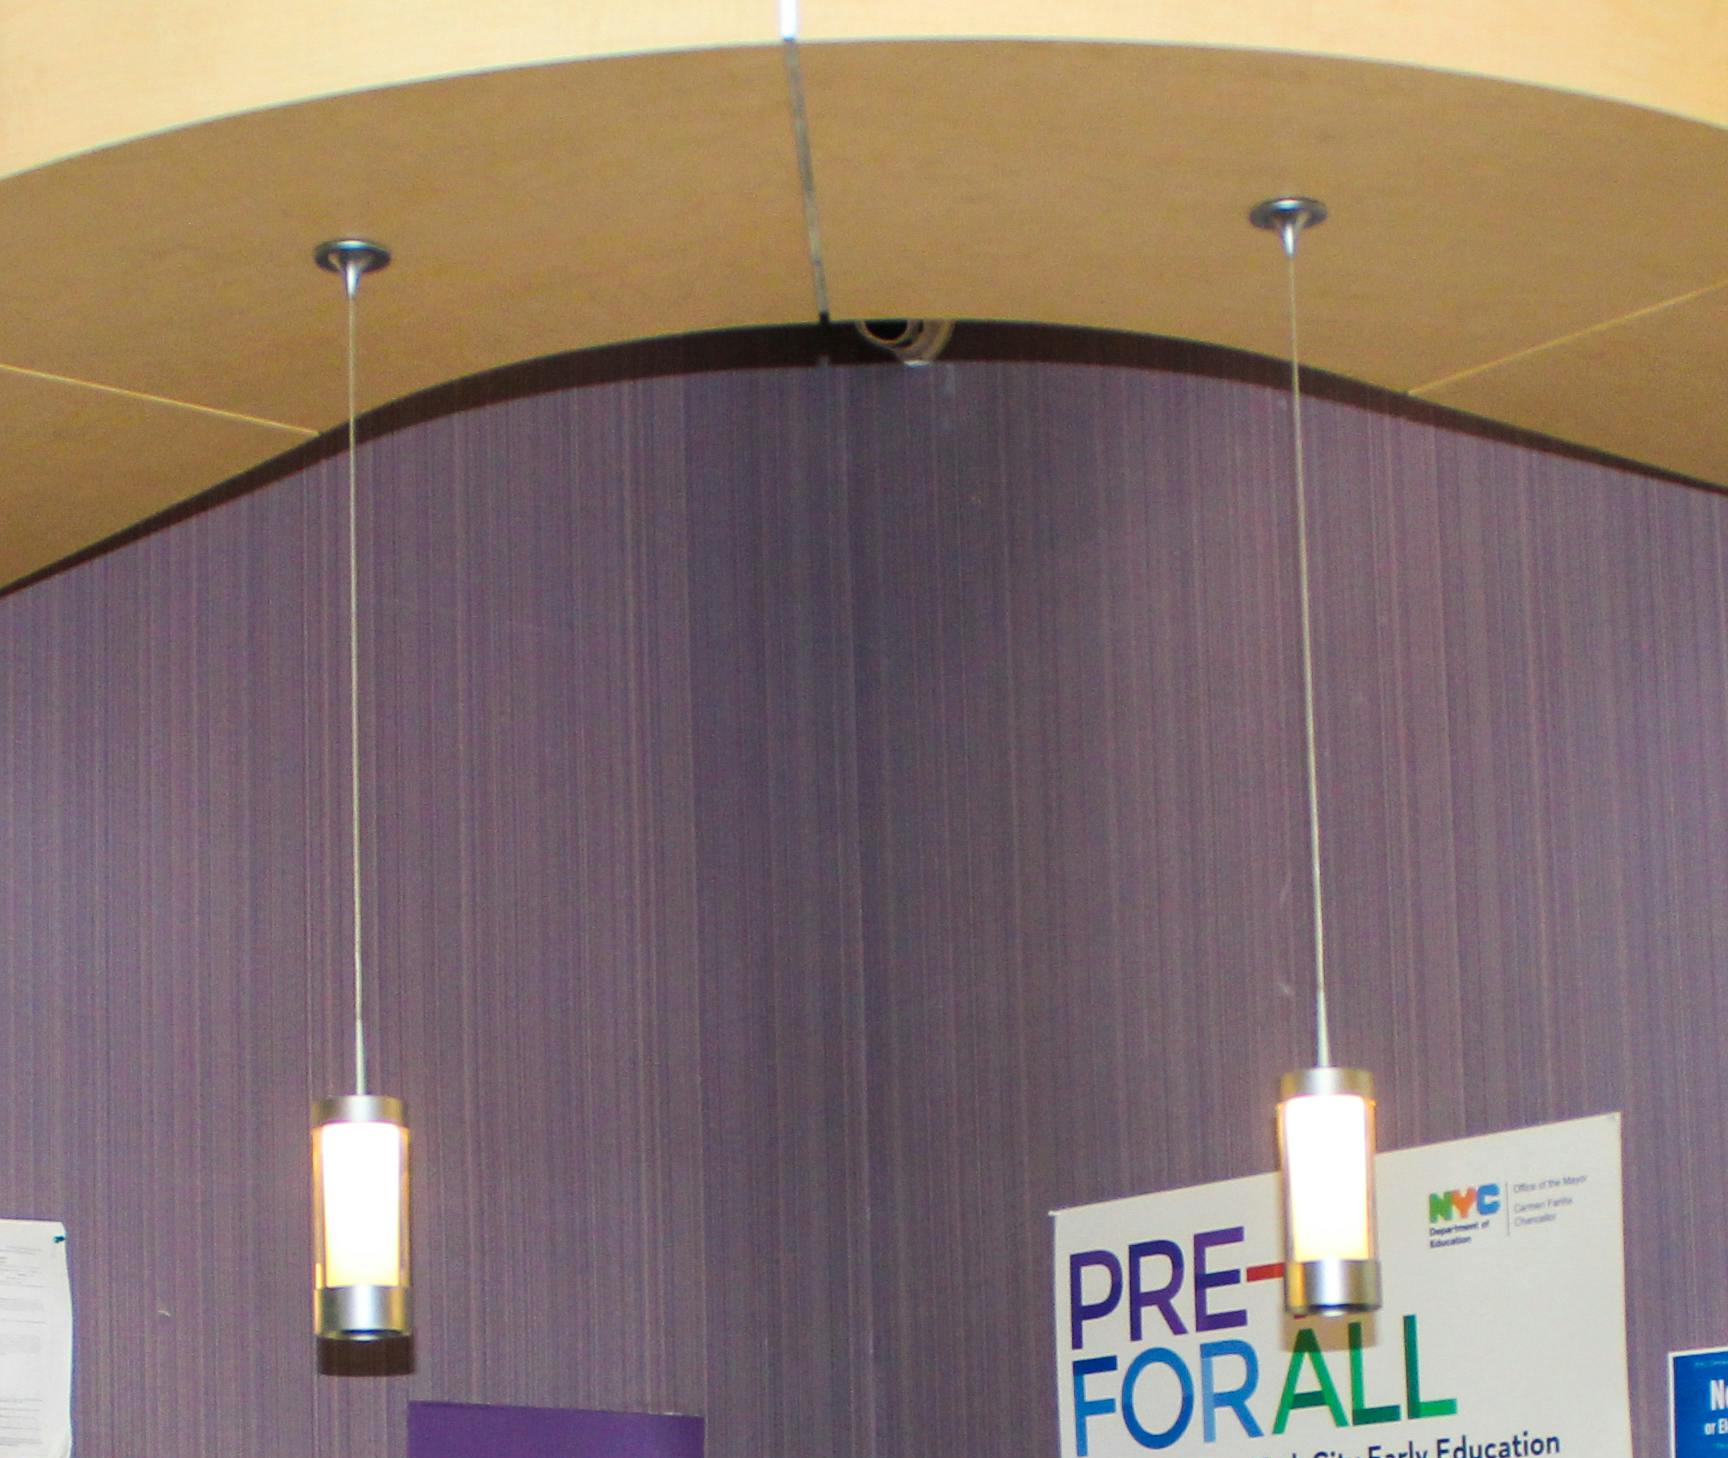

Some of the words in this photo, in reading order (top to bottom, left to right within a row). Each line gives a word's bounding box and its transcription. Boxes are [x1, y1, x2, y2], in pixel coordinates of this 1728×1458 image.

[1428, 1183, 1501, 1223] NYC
[1430, 1222, 1478, 1237] Department
[1481, 1220, 1490, 1229] of
[1430, 1236, 1472, 1248] Education
[1071, 1338, 1265, 1458] FOR
[1271, 1314, 1458, 1435] ALL
[1704, 1422, 1716, 1435] or
